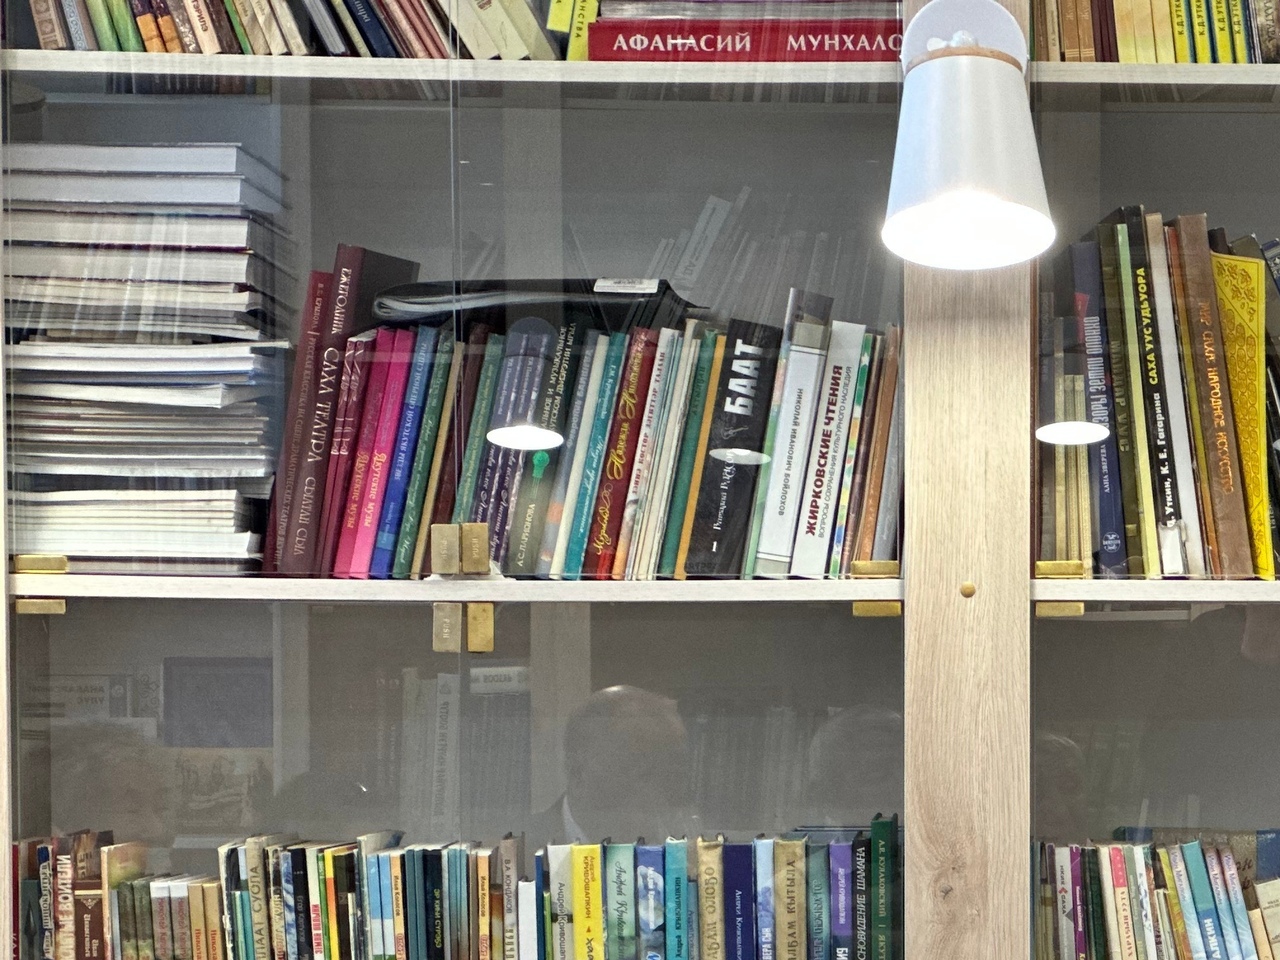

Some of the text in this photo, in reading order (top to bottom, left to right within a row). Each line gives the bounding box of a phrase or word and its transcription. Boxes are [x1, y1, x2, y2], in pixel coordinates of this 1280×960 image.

[612, 31, 751, 52] АФАНАСИЙ
[330, 267, 351, 335] ЕЖЕГОДНИК
[1136, 267, 1158, 384] САХА УУС УДЬУОРА
[317, 346, 340, 395] САХА
[549, 326, 566, 384] МУЗЫКАЛЬНОЕ
[1109, 340, 1129, 451] МАНДАР УУС
[1205, 367, 1225, 427] НАРОДНОЕ
[306, 399, 331, 463] ТЕАТРА
[399, 410, 414, 451] ЯКУТСКОЙ
[604, 420, 632, 481] Надежда
[777, 388, 804, 516] НИКОЛАЙ ИВАНОВИЧ БОЙЛОХОВ
[805, 364, 843, 535] ЖИРКОВСКИЕ ЧТЕНИЯ
[817, 366, 853, 537] ВОПРОСЫ СОХРАНЕНИЯ КУЛЬТУРНОГО НАСЛЕДИЯ
[1151, 392, 1175, 514] Уткин, К. Е. Гагарина
[346, 451, 369, 528] Якутские музы
[363, 450, 386, 526] Якутские музы
[56, 855, 72, 910] ВОИТЕЛИ
[248, 866, 262, 912] СУОЛА
[433, 888, 439, 898] ЭР
[504, 874, 512, 913] КОНДАКОВ
[557, 882, 565, 913] Андрей
[611, 861, 626, 895] Андрей
[784, 859, 796, 913] КЫТЫЛА
[856, 846, 867, 960] СНОВИДЕНИЕ ШАМАНА
[877, 857, 886, 916] КУЛАКОВСКИЙ
[761, 927, 771, 941] СЫН
